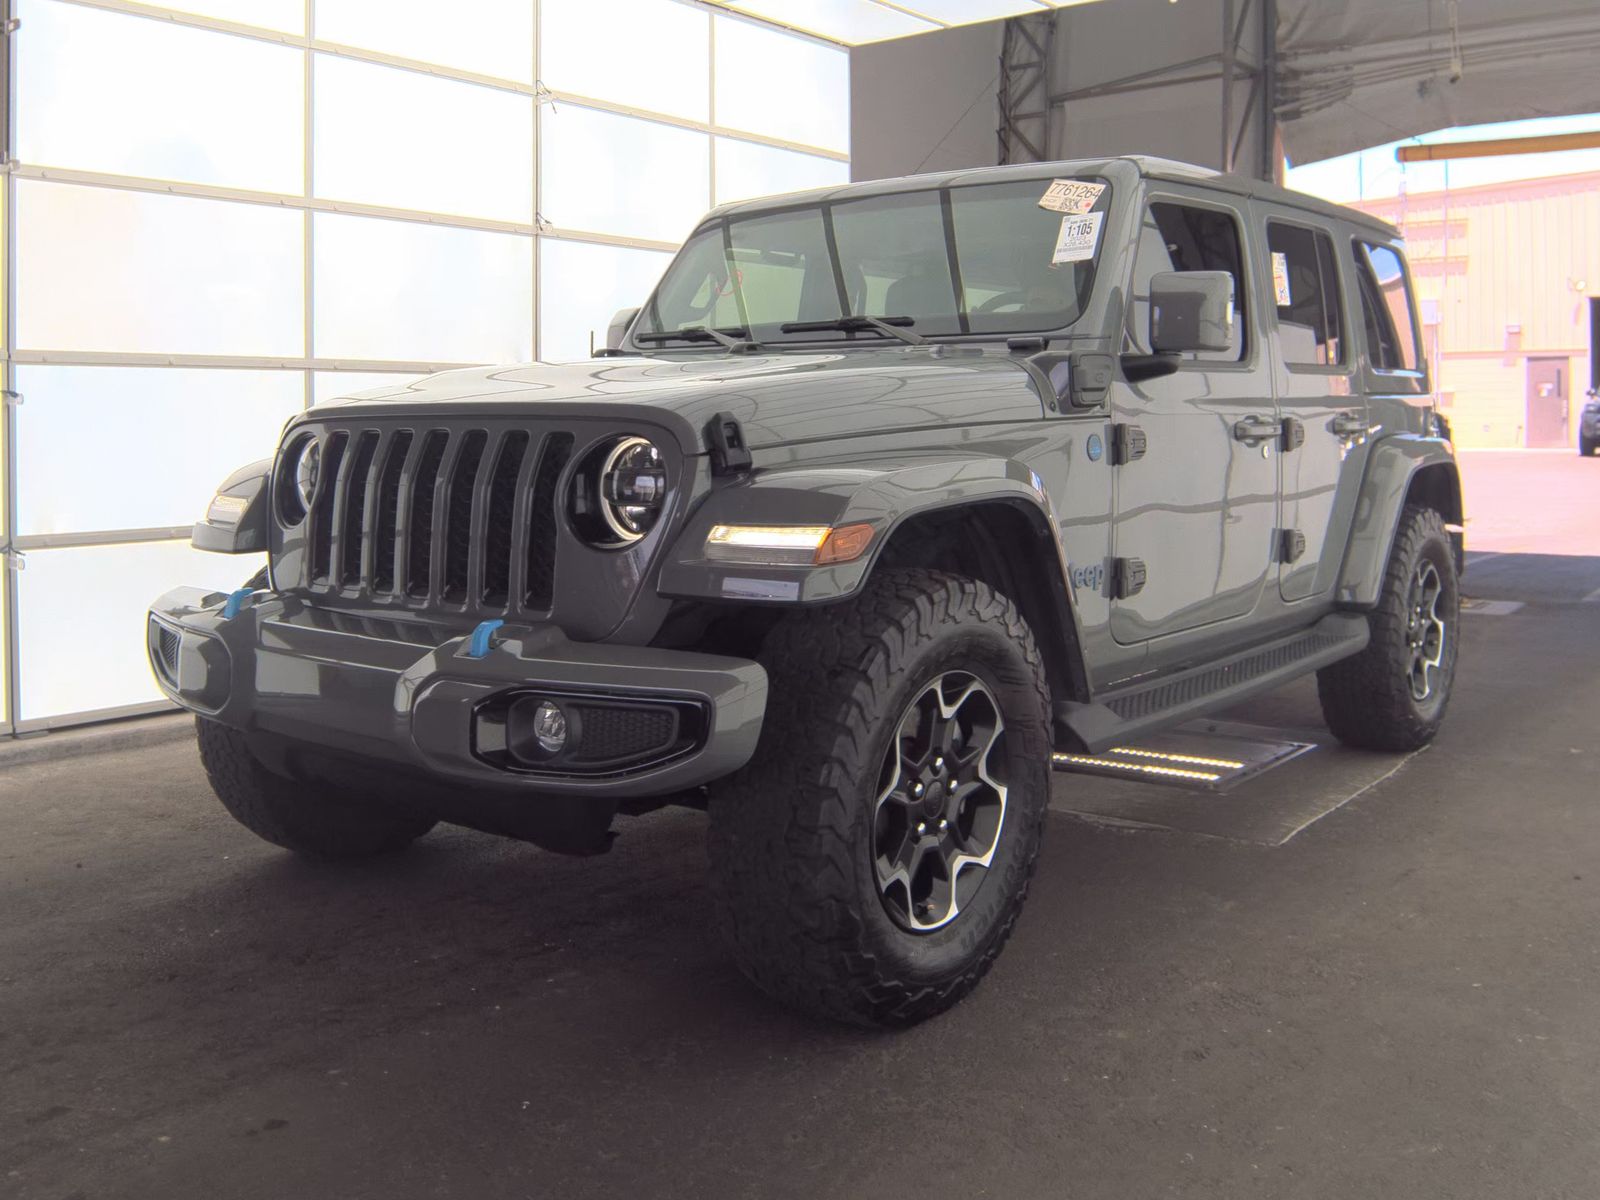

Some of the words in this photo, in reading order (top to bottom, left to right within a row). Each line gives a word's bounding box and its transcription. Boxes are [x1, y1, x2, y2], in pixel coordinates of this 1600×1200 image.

[1050, 183, 1102, 199] 7761264
[1067, 222, 1093, 237] 1:105
[1069, 563, 1104, 591] eep
